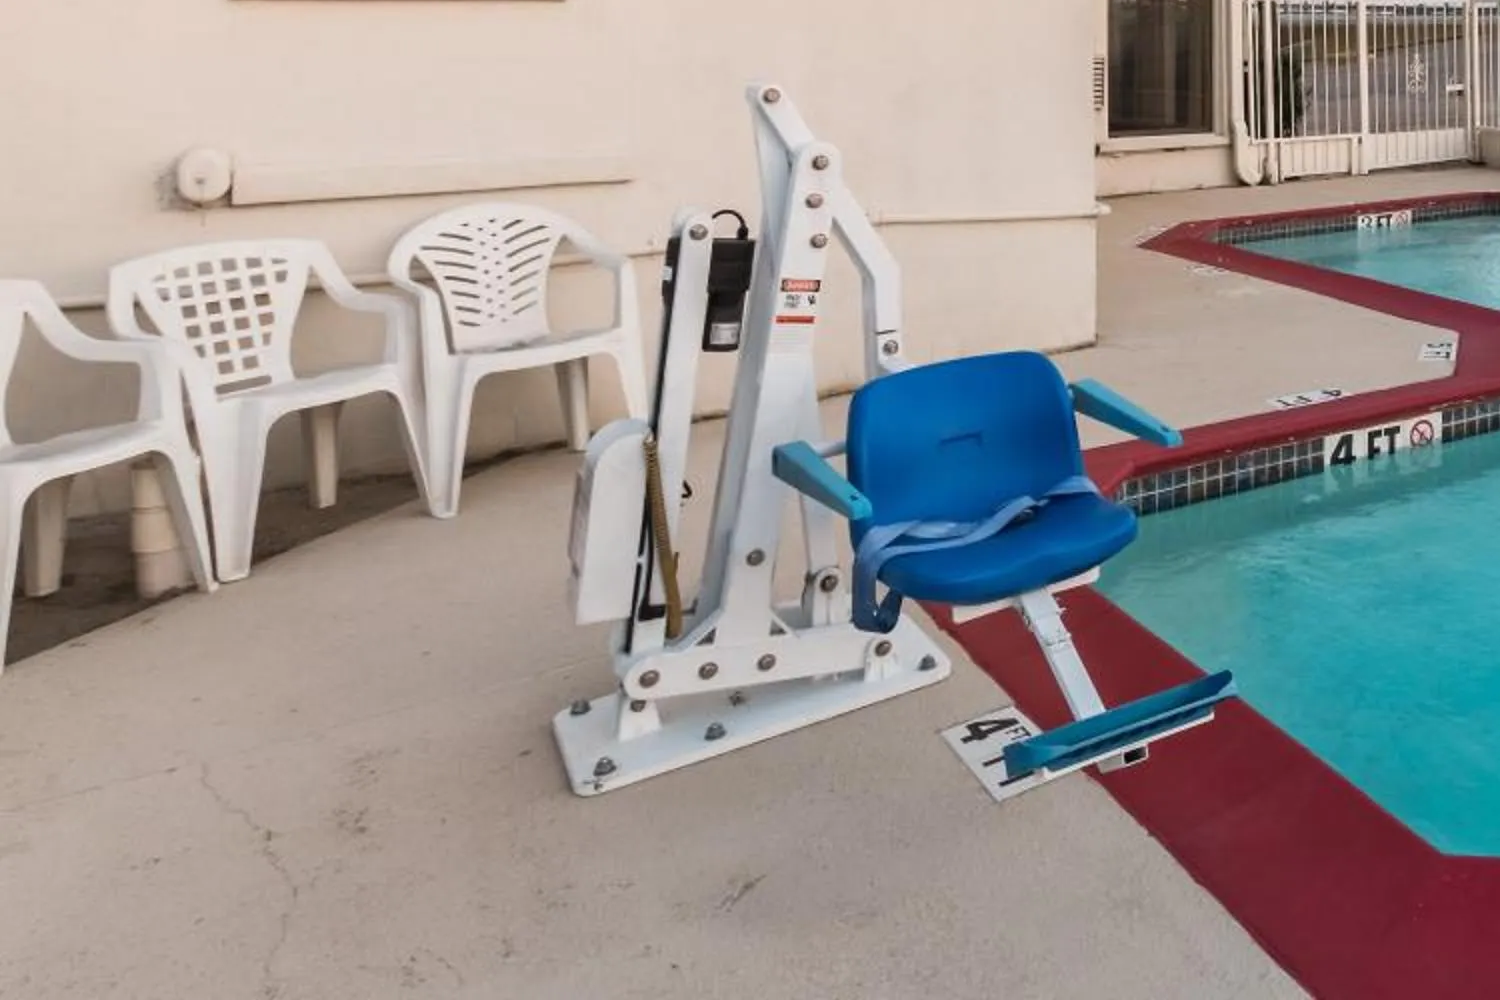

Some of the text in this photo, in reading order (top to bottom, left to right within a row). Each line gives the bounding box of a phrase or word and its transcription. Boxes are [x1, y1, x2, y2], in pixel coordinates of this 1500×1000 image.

[1330, 425, 1401, 466] 4 FT
[960, 717, 1020, 744] 4
